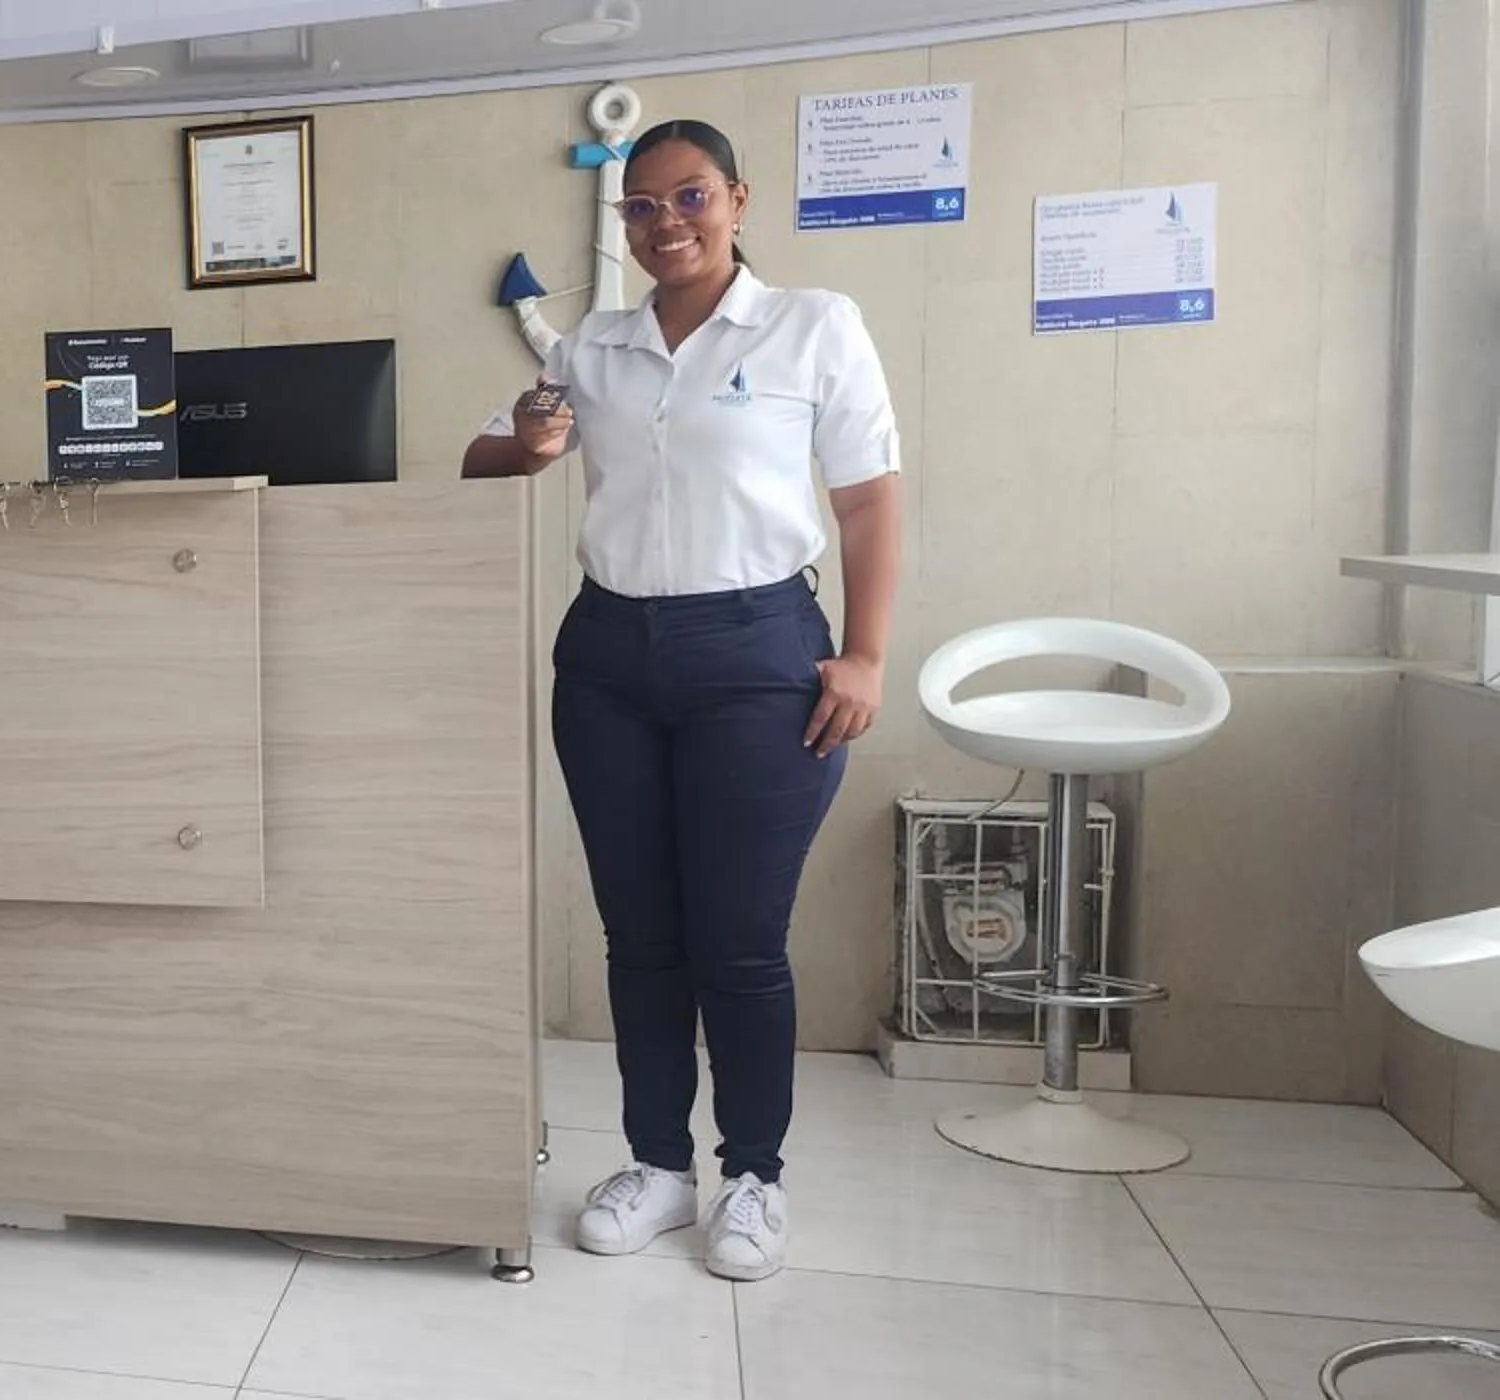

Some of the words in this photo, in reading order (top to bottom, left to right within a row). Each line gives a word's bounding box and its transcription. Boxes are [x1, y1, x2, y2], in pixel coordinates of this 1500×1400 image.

[815, 95, 873, 111] TARIFAS
[876, 93, 897, 107] DE
[900, 87, 958, 104] PLANES
[935, 197, 959, 211] 8,6
[180, 402, 247, 420] ASUS
